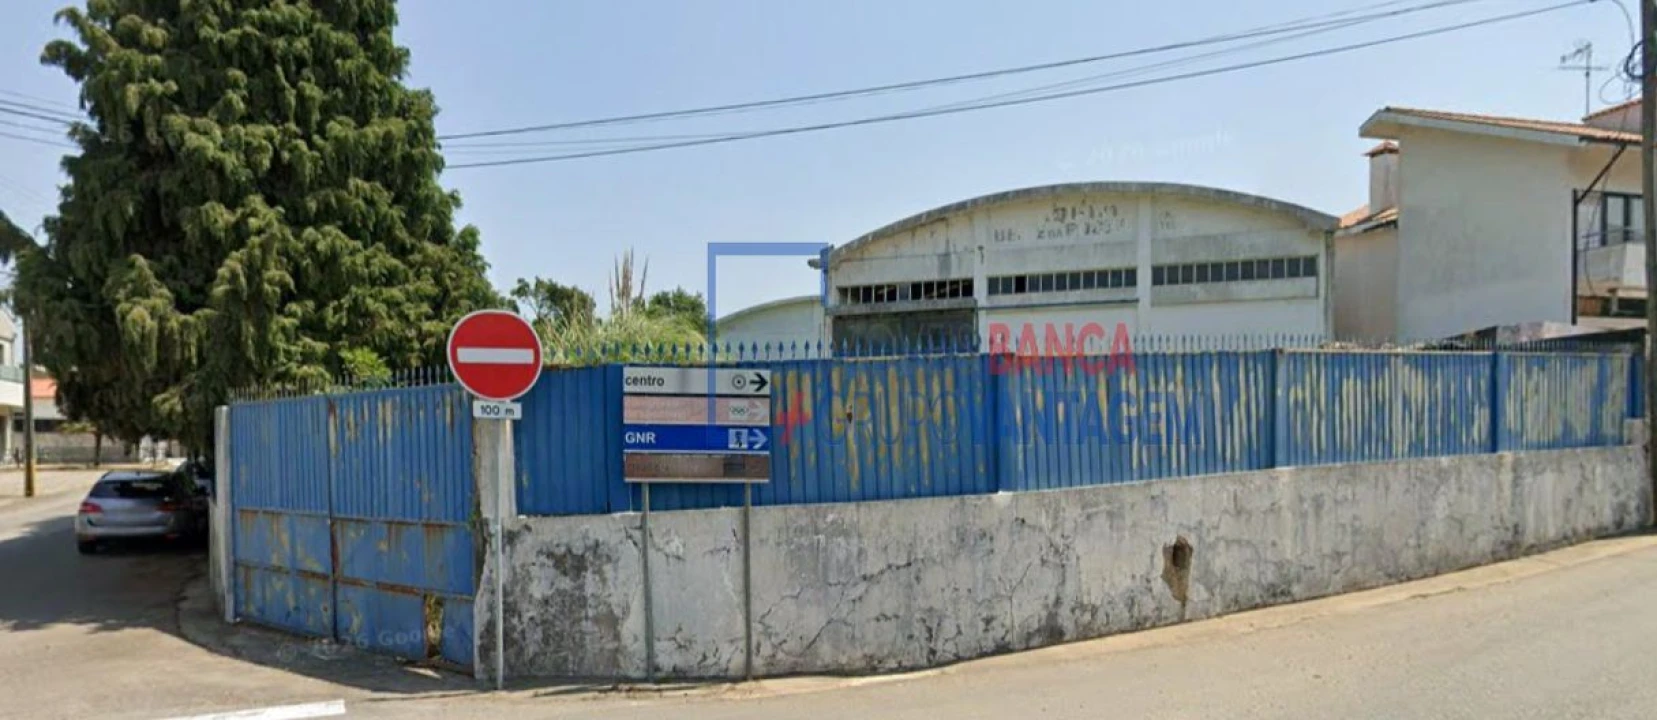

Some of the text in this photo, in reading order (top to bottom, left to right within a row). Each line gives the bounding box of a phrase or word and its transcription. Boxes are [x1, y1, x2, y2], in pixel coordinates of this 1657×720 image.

[625, 374, 665, 387] centro
[480, 404, 515, 416] 100 m
[625, 431, 656, 444] GNR
